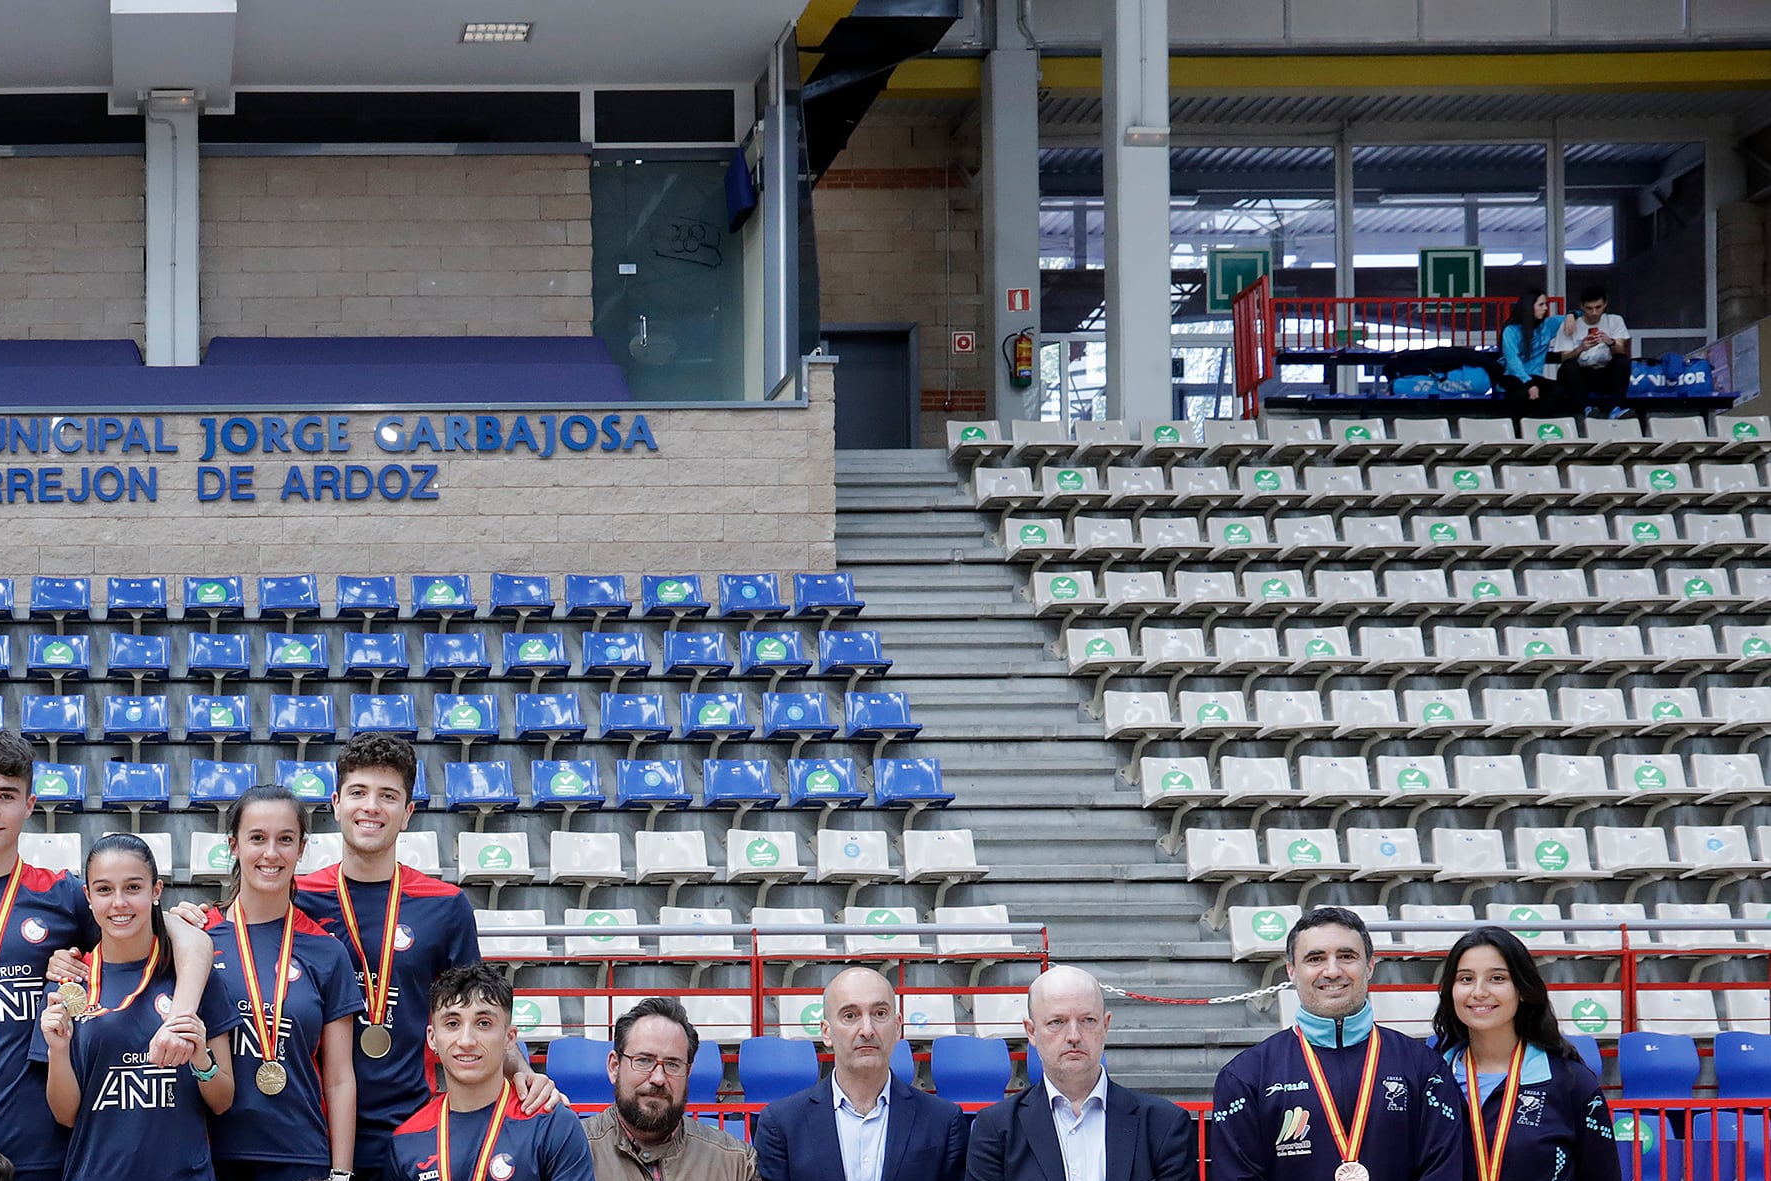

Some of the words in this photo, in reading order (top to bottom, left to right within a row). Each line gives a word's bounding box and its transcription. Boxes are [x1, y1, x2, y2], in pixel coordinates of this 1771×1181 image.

[199, 415, 351, 463] JORGE
[374, 413, 659, 459] GARBAJOSA
[197, 465, 256, 502] DE
[280, 464, 441, 502] ARDOZ
